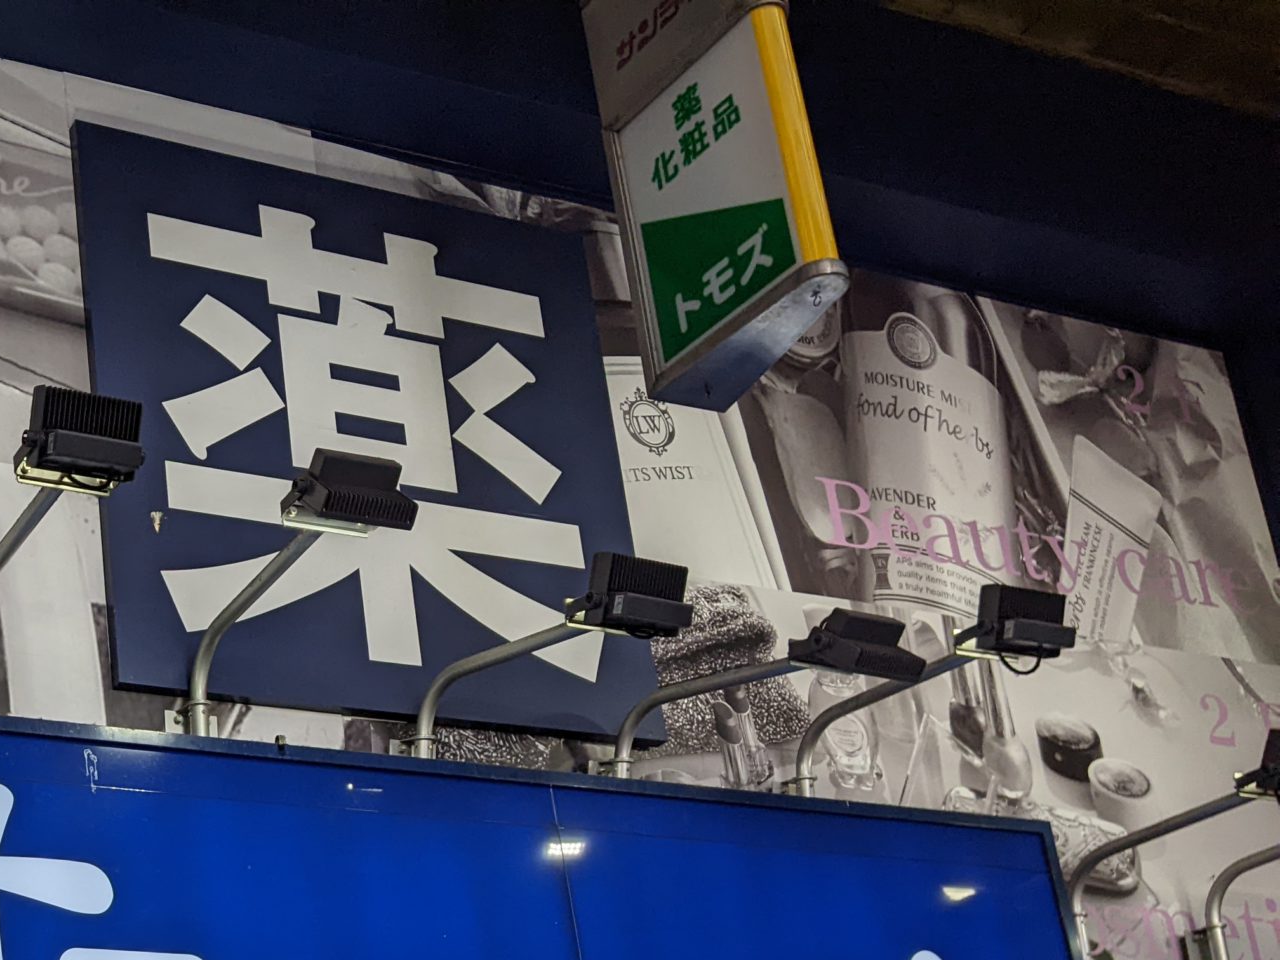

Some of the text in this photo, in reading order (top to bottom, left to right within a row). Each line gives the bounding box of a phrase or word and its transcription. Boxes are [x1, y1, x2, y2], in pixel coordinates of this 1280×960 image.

[672, 82, 702, 131] 薬
[650, 94, 742, 191] 化粧品
[675, 222, 774, 334] トモズ
[864, 372, 935, 399] MOISTURE
[147, 204, 605, 683] 薬
[633, 415, 662, 435] LW
[866, 486, 937, 511] AVENDER
[814, 476, 1087, 594] Beauty
[1115, 548, 1241, 614] care
[1200, 693, 1237, 748] 2
